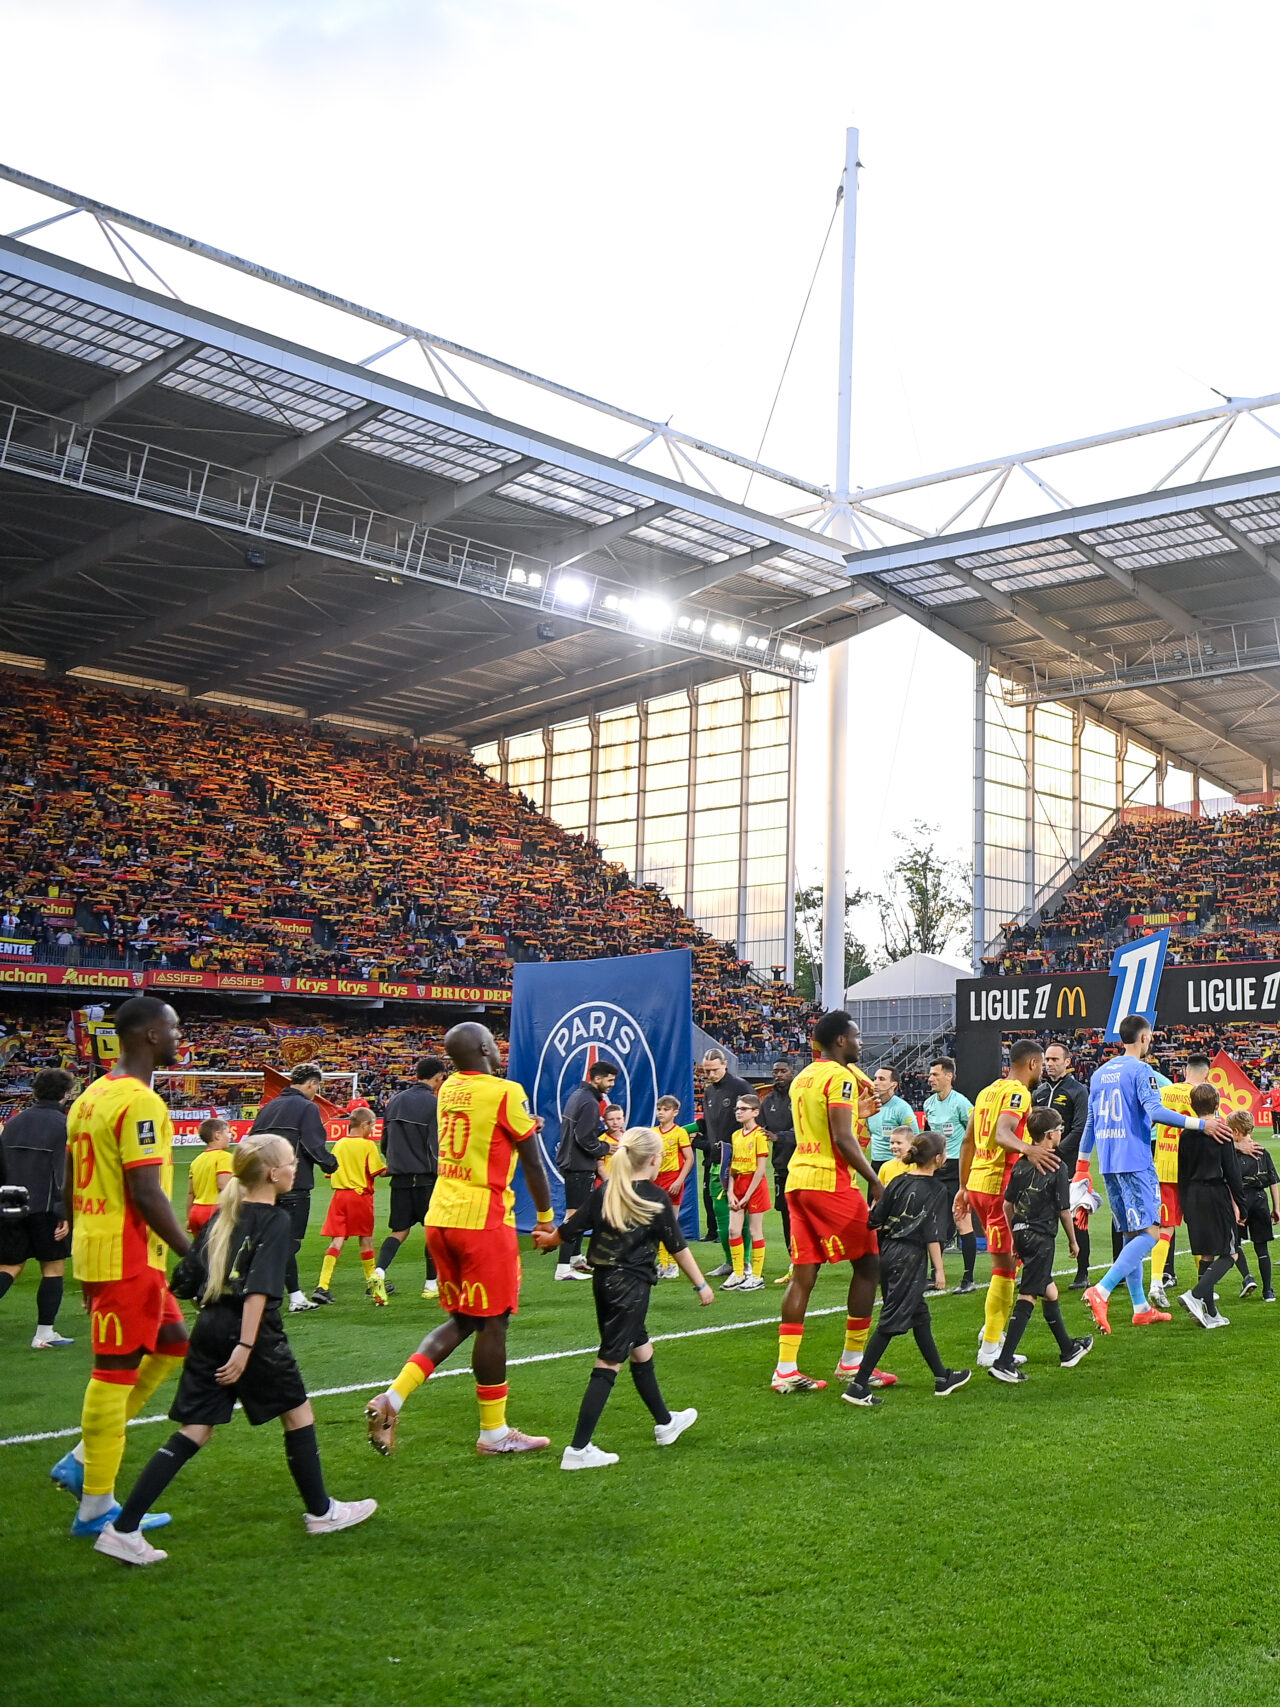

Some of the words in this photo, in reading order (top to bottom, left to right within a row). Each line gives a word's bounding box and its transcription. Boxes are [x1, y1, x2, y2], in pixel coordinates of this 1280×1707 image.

[1143, 913, 1170, 925] PUMA
[62, 967, 129, 988] Auchan
[296, 977, 329, 993] Krys
[337, 980, 368, 995] Krys
[379, 981, 409, 997] Krys
[431, 986, 481, 1000] BRICO
[1188, 976, 1257, 1013] LIGUE
[970, 988, 1030, 1022] LIGUE
[553, 1011, 636, 1057] PARIS
[1097, 1088, 1124, 1124] 40
[439, 1110, 471, 1160] 20
[980, 1108, 991, 1144] 14
[1096, 1128, 1127, 1140] WINAMAX
